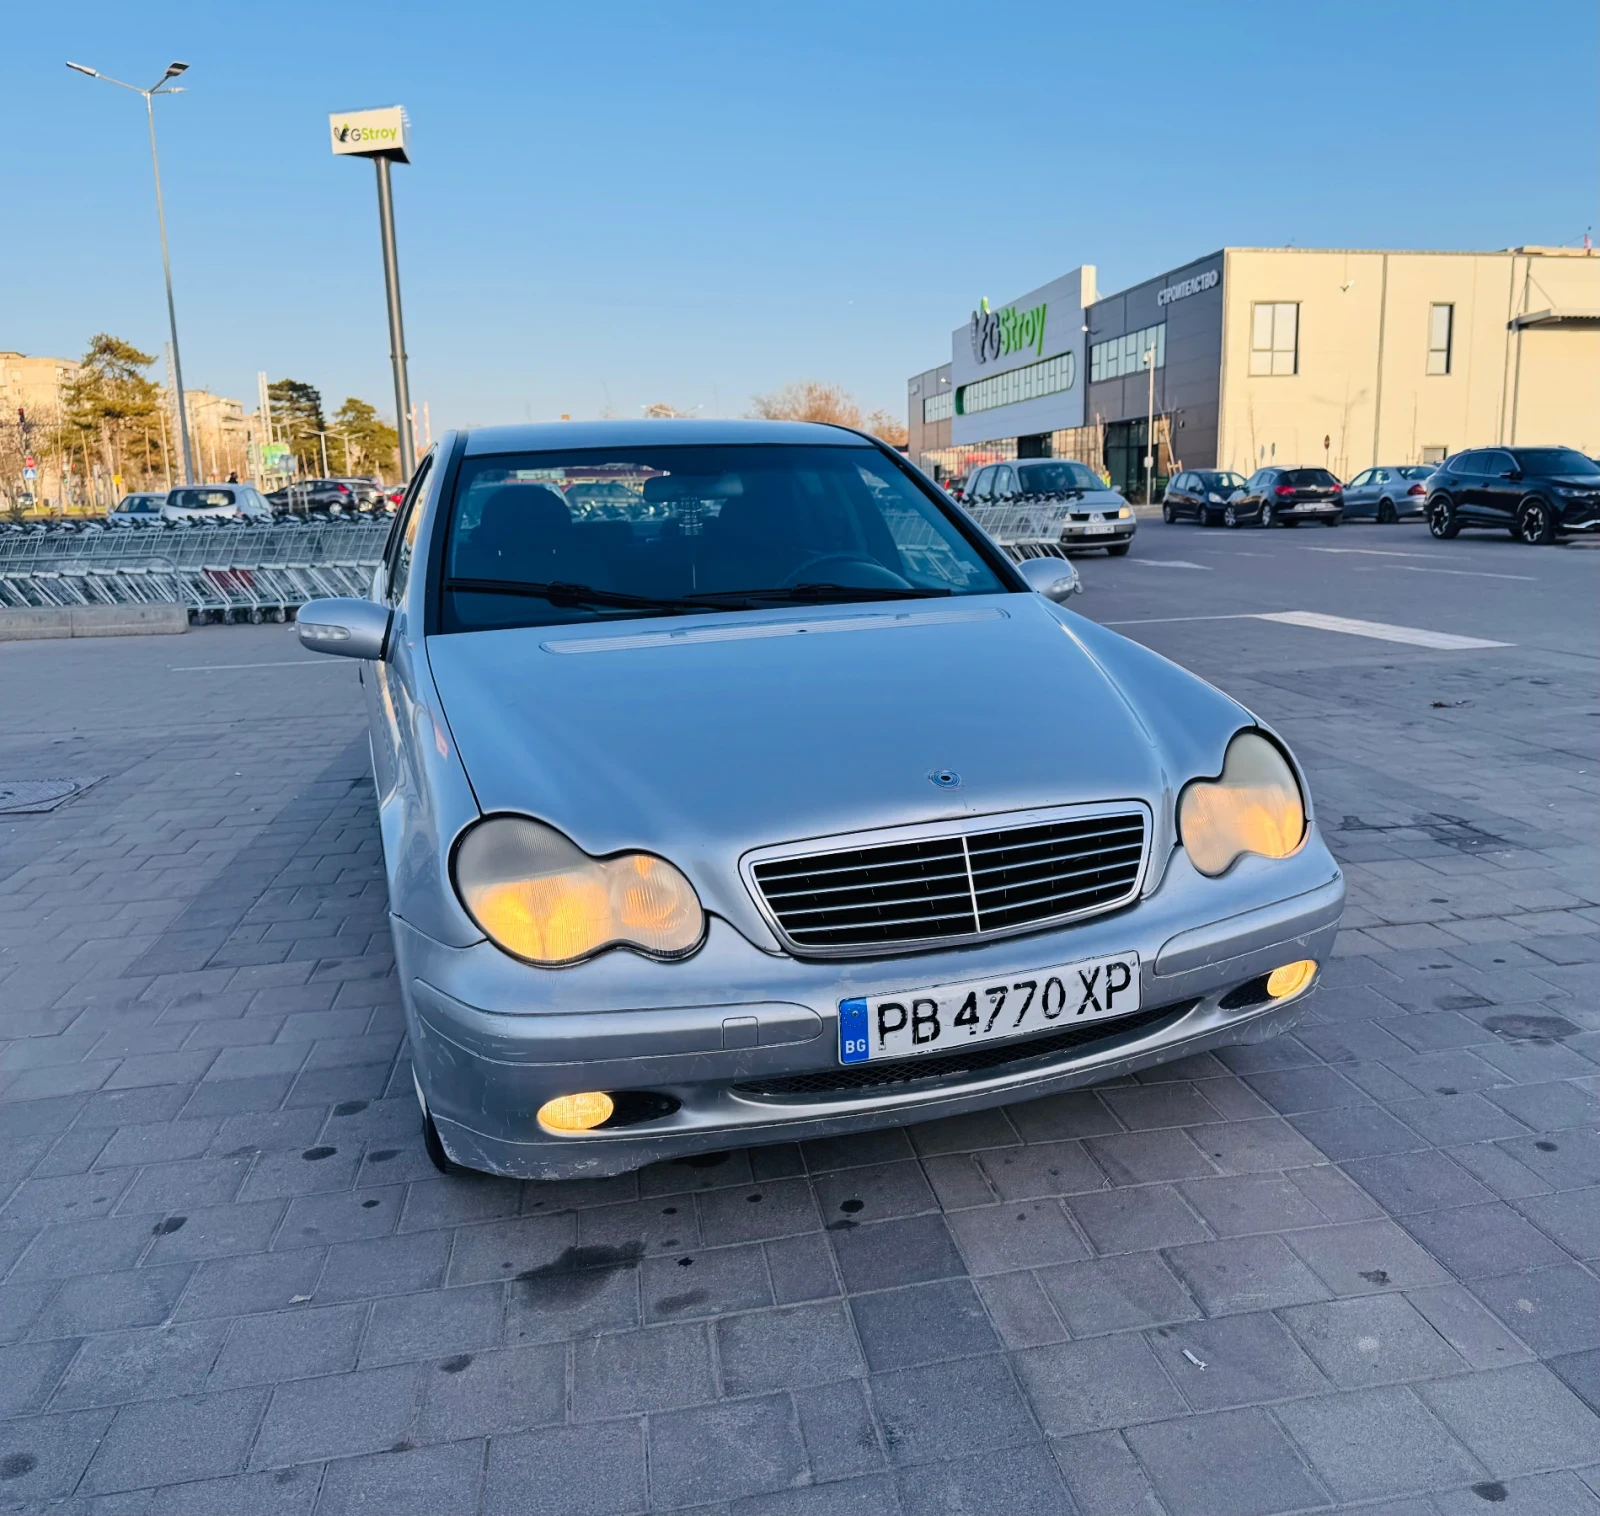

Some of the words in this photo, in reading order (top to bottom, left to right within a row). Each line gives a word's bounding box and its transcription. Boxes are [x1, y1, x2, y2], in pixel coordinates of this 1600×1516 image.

[350, 127, 397, 142] GStroy
[988, 303, 1047, 361] GStroy
[877, 998, 941, 1051] PB
[953, 977, 1067, 1035] 4770
[1076, 961, 1132, 1016] XP
[845, 1039, 867, 1055] BG
